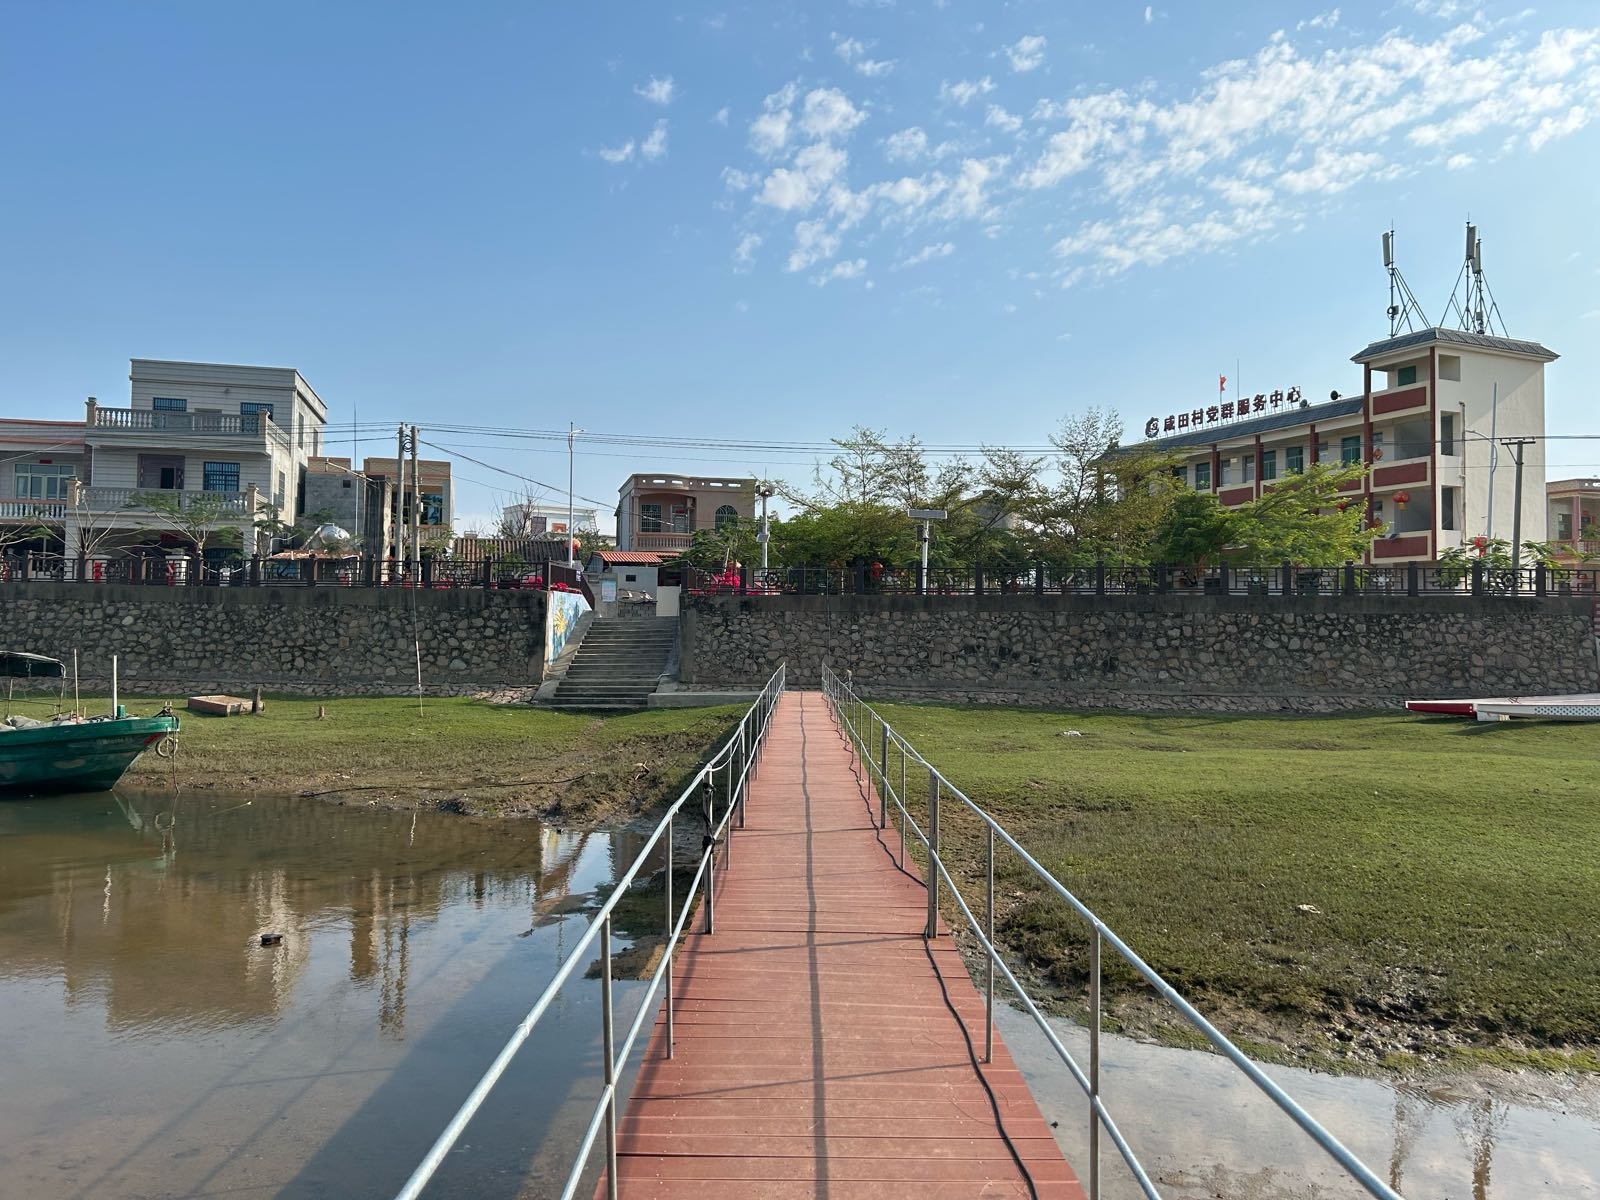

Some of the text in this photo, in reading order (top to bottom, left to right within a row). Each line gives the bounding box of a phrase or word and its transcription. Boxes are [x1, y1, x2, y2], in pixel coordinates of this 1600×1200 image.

[1164, 386, 1301, 431] 咸田村党群服务中心
